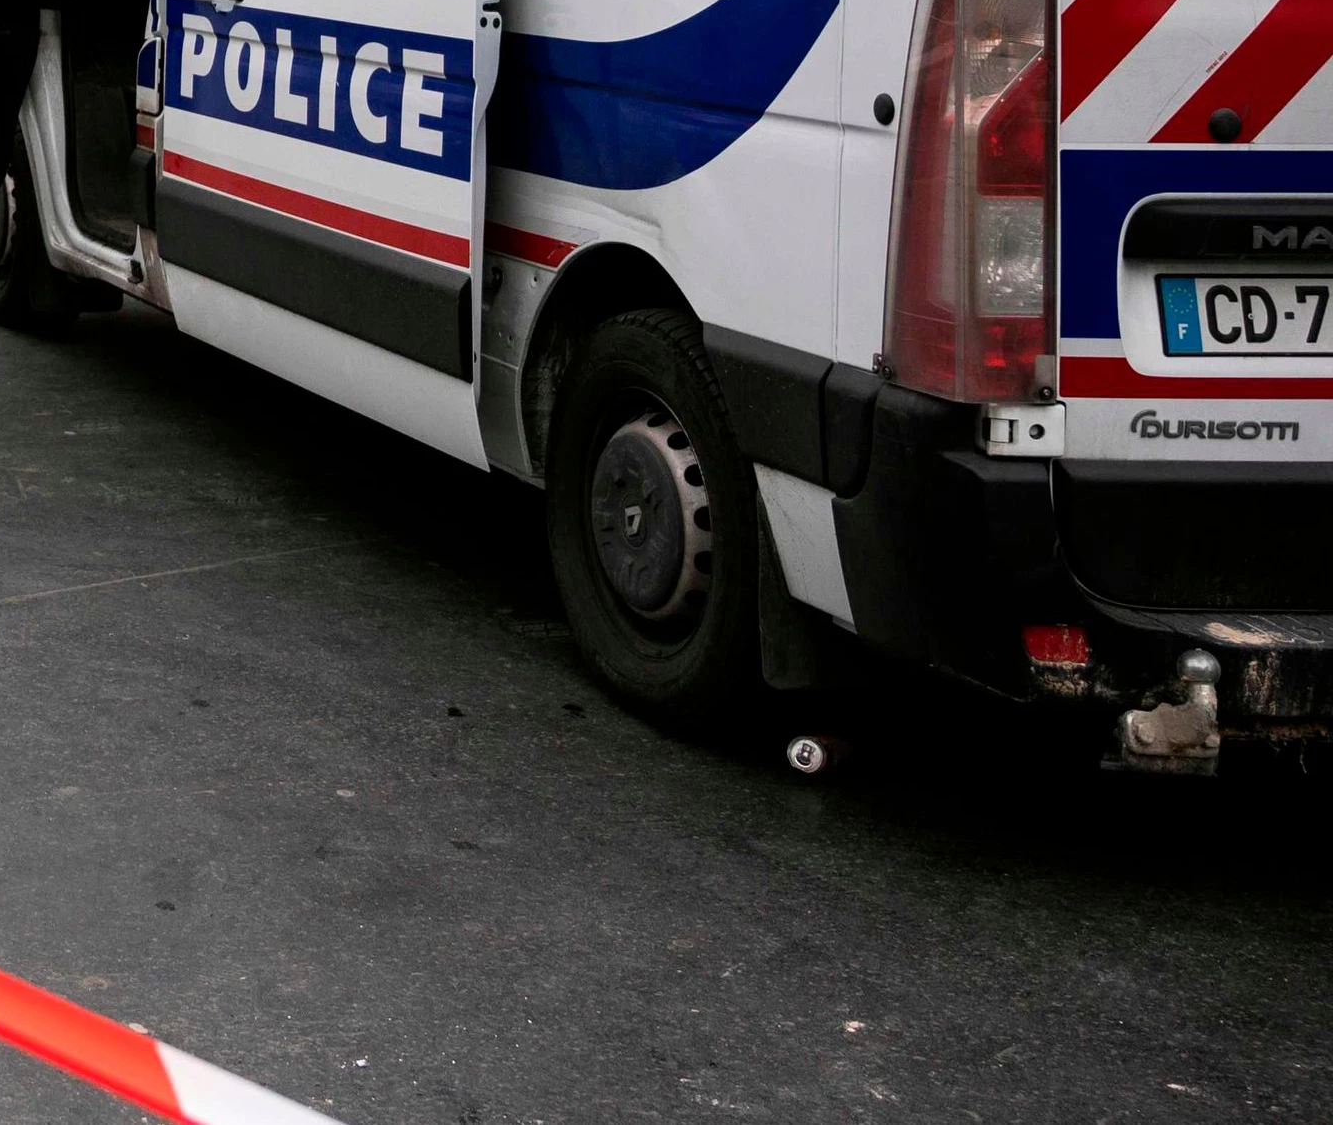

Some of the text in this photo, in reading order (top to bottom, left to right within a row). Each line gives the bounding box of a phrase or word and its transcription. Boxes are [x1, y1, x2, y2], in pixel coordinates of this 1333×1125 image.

[180, 13, 446, 157] POLICE
[1178, 323, 1188, 340] F
[1133, 413, 1299, 442] DURISOTTI
